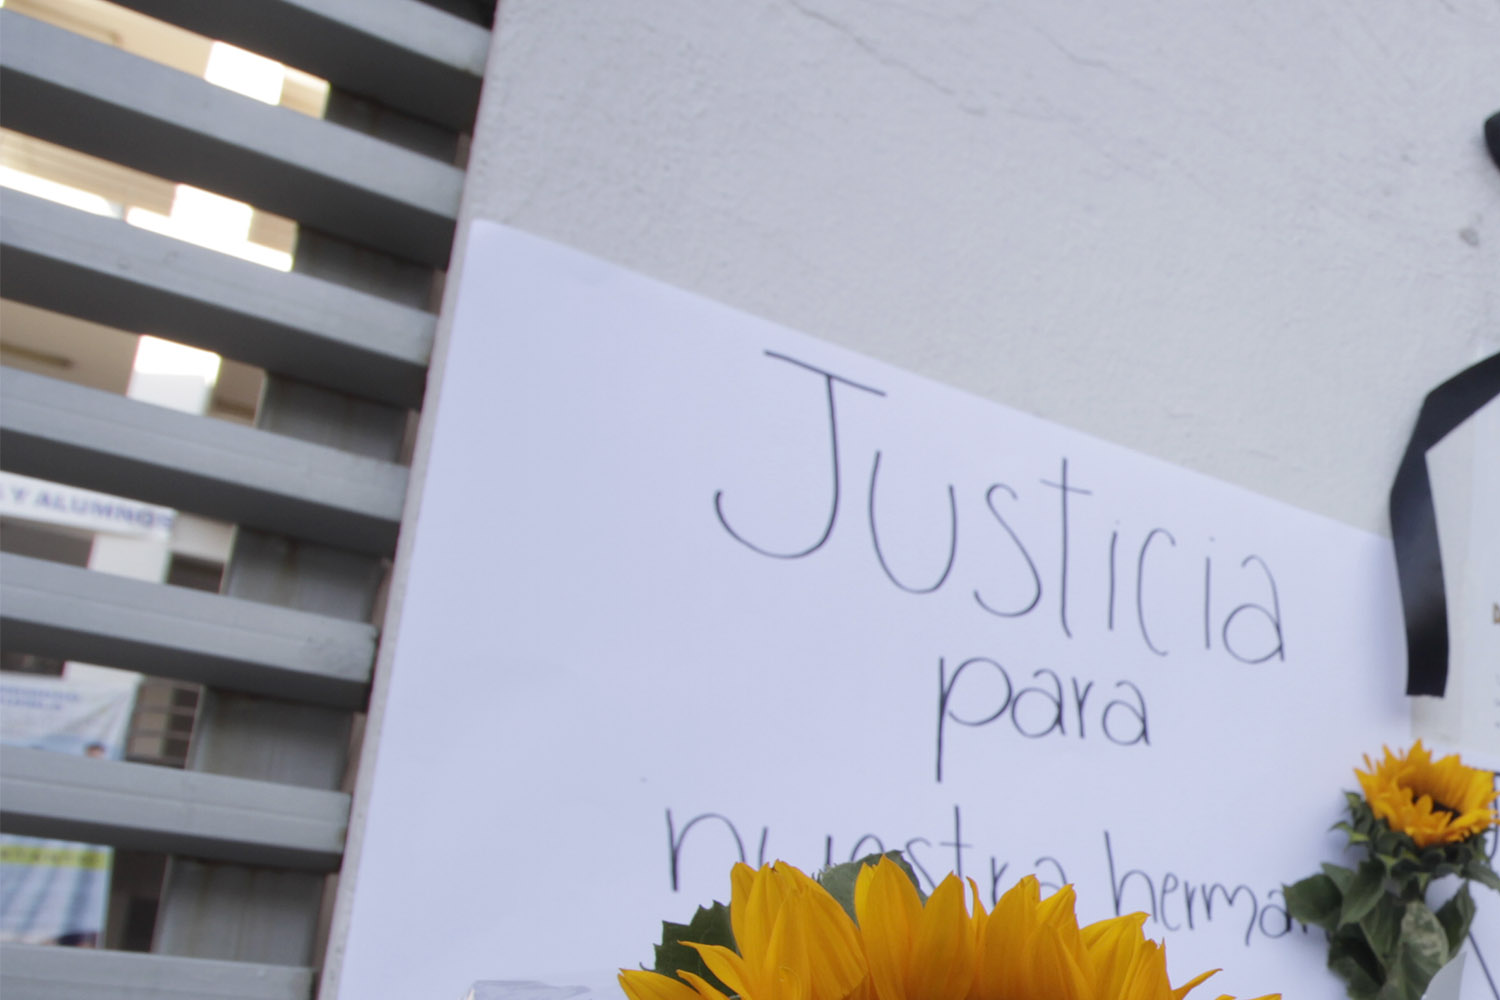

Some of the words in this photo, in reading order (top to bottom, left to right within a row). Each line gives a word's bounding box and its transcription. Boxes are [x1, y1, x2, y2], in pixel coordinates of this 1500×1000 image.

[714, 349, 1286, 664] Justicia
[936, 656, 1150, 783] para
[1103, 828, 1309, 947] herma
